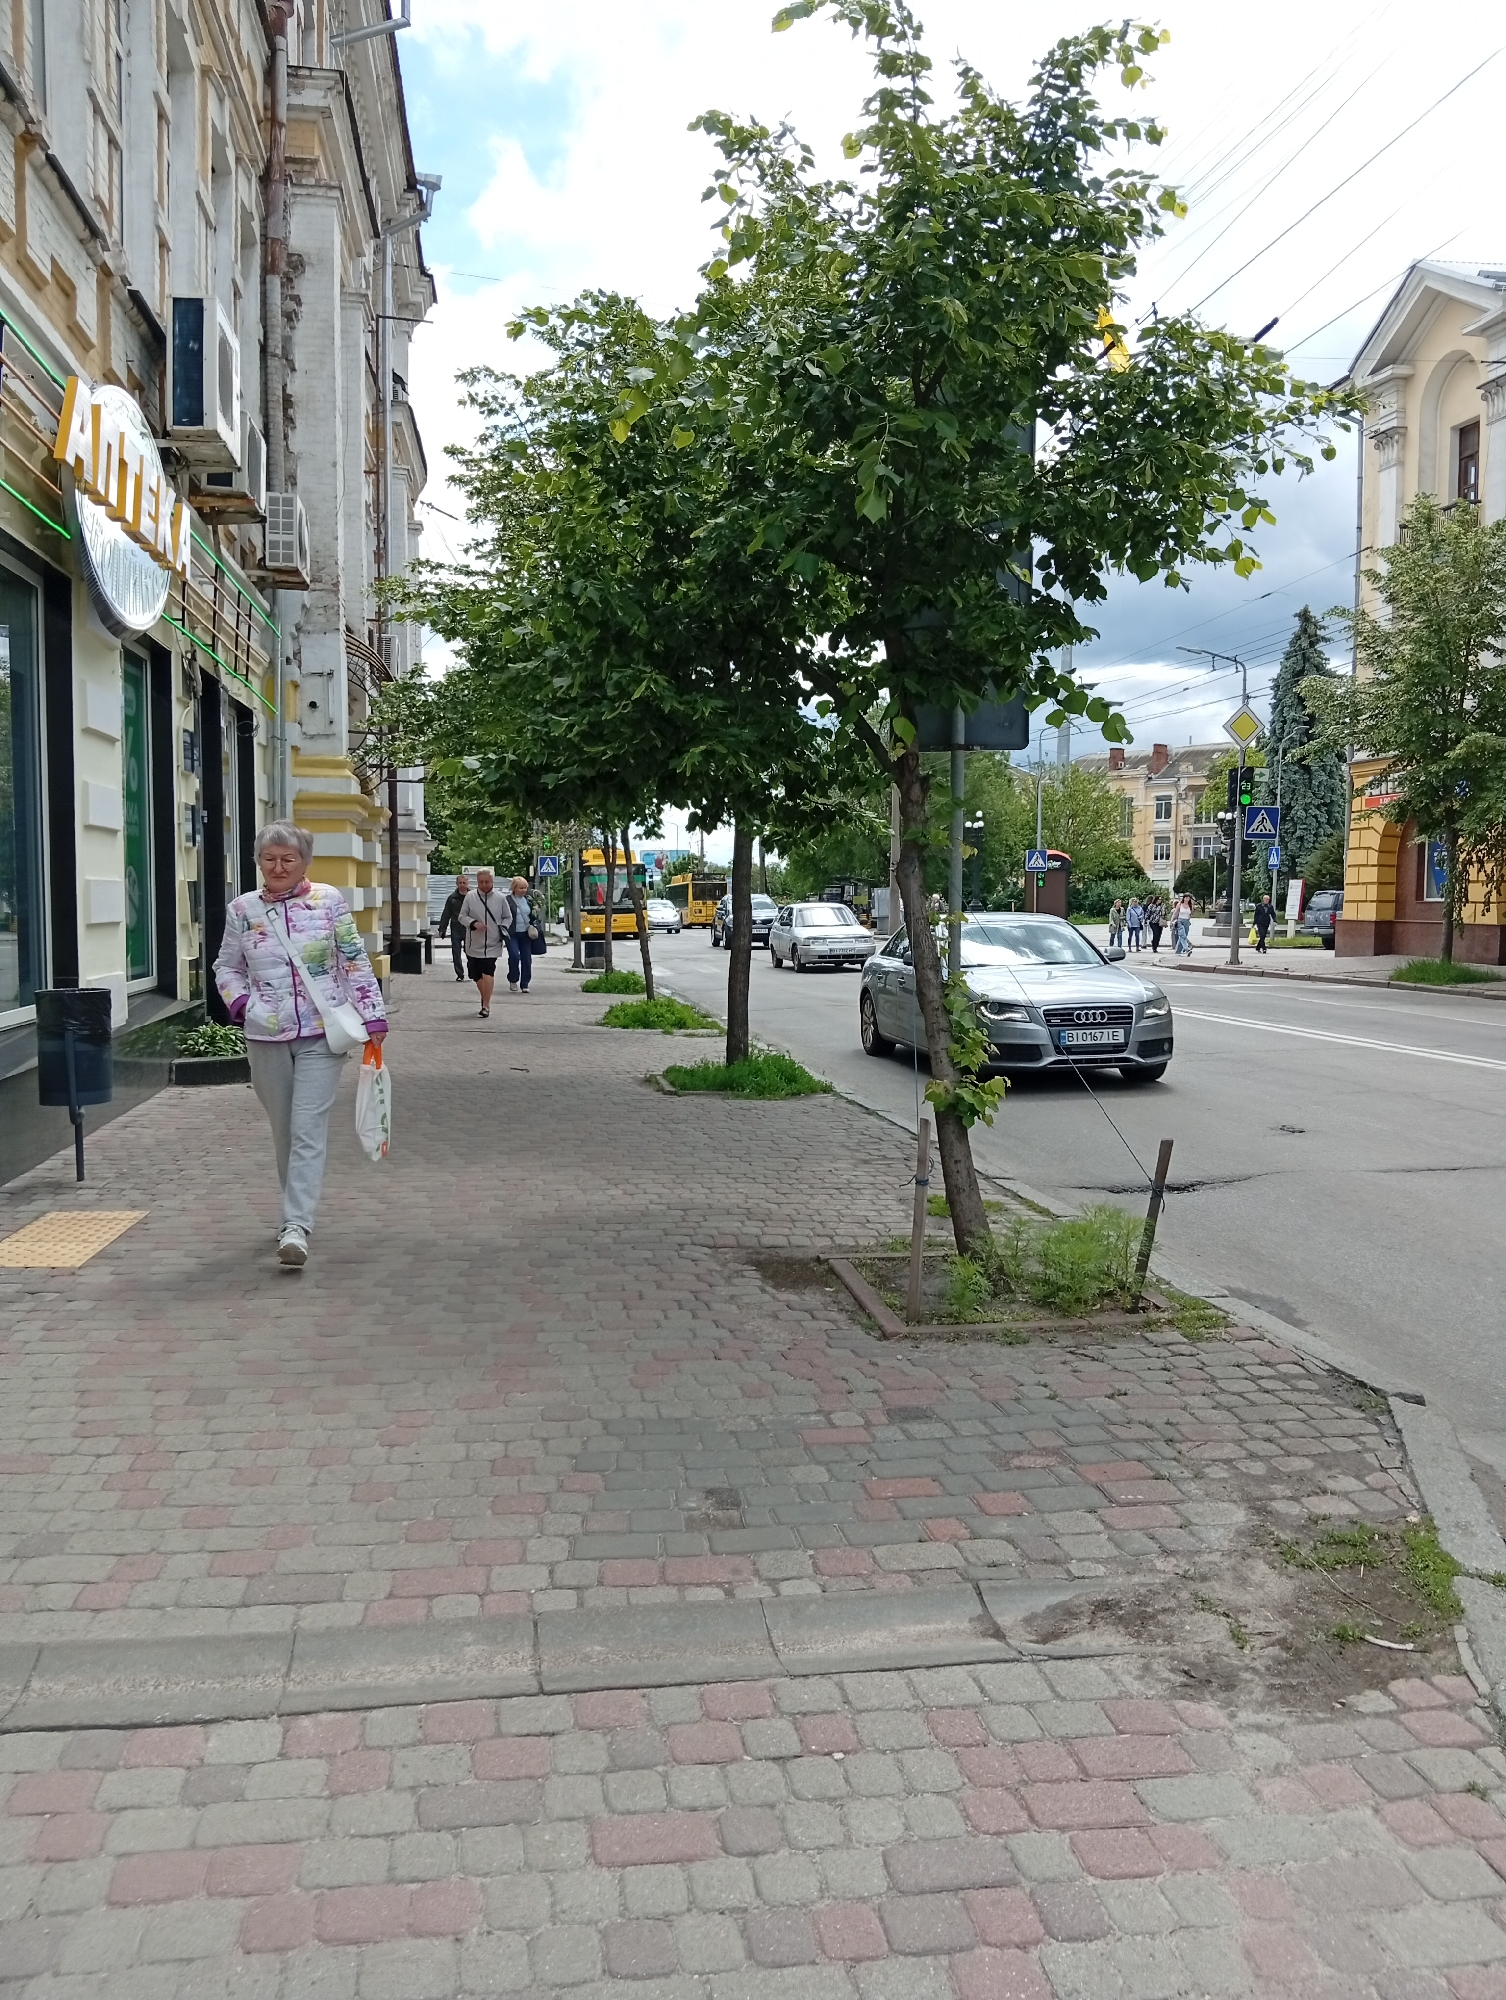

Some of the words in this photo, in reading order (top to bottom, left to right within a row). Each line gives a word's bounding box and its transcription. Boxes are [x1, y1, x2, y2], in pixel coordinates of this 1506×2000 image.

[54, 376, 191, 582] АПТЕКА
[1241, 782, 1251, 790] 23
[1081, 1031, 1105, 1042] 0167
